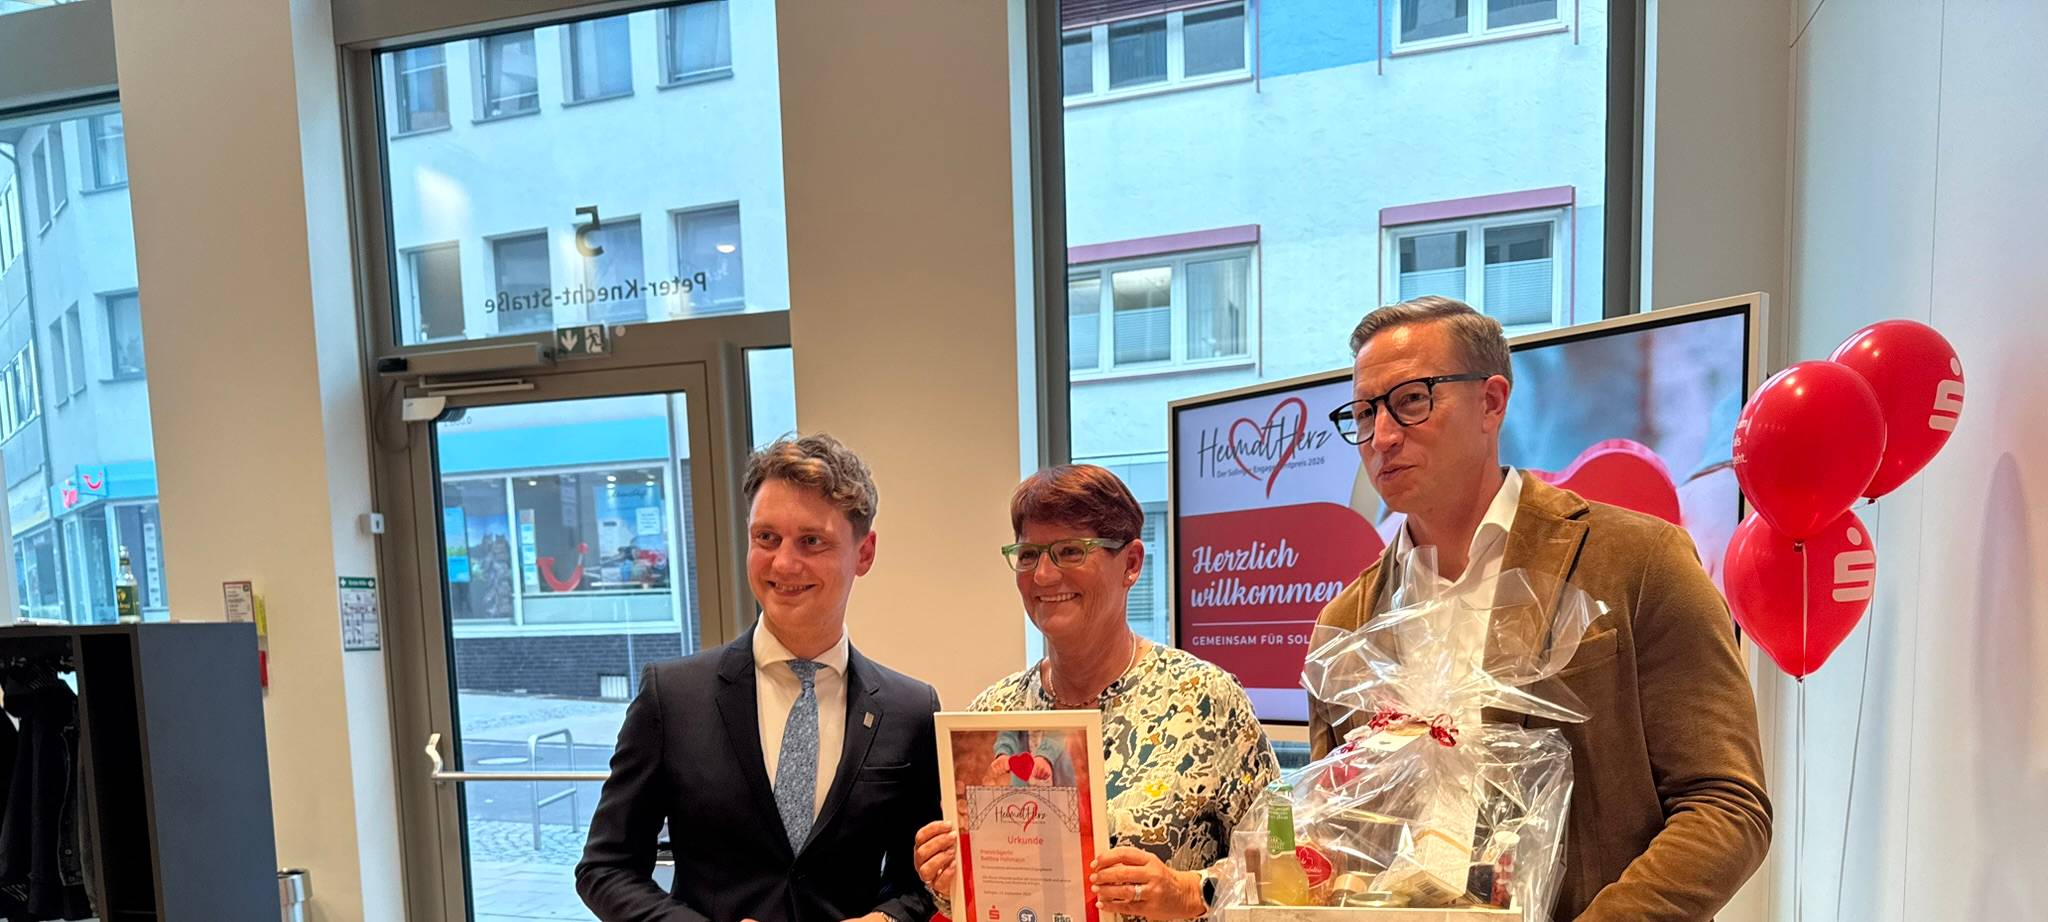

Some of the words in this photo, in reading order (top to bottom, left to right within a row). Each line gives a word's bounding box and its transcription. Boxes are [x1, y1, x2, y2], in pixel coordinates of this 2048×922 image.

[1192, 538, 1299, 575] Herzlich
[1191, 577, 1344, 608] willkommen
[1192, 634, 1257, 647] GEMEINSAM
[1260, 633, 1284, 645] FÜR
[1008, 836, 1044, 845] Urkunde
